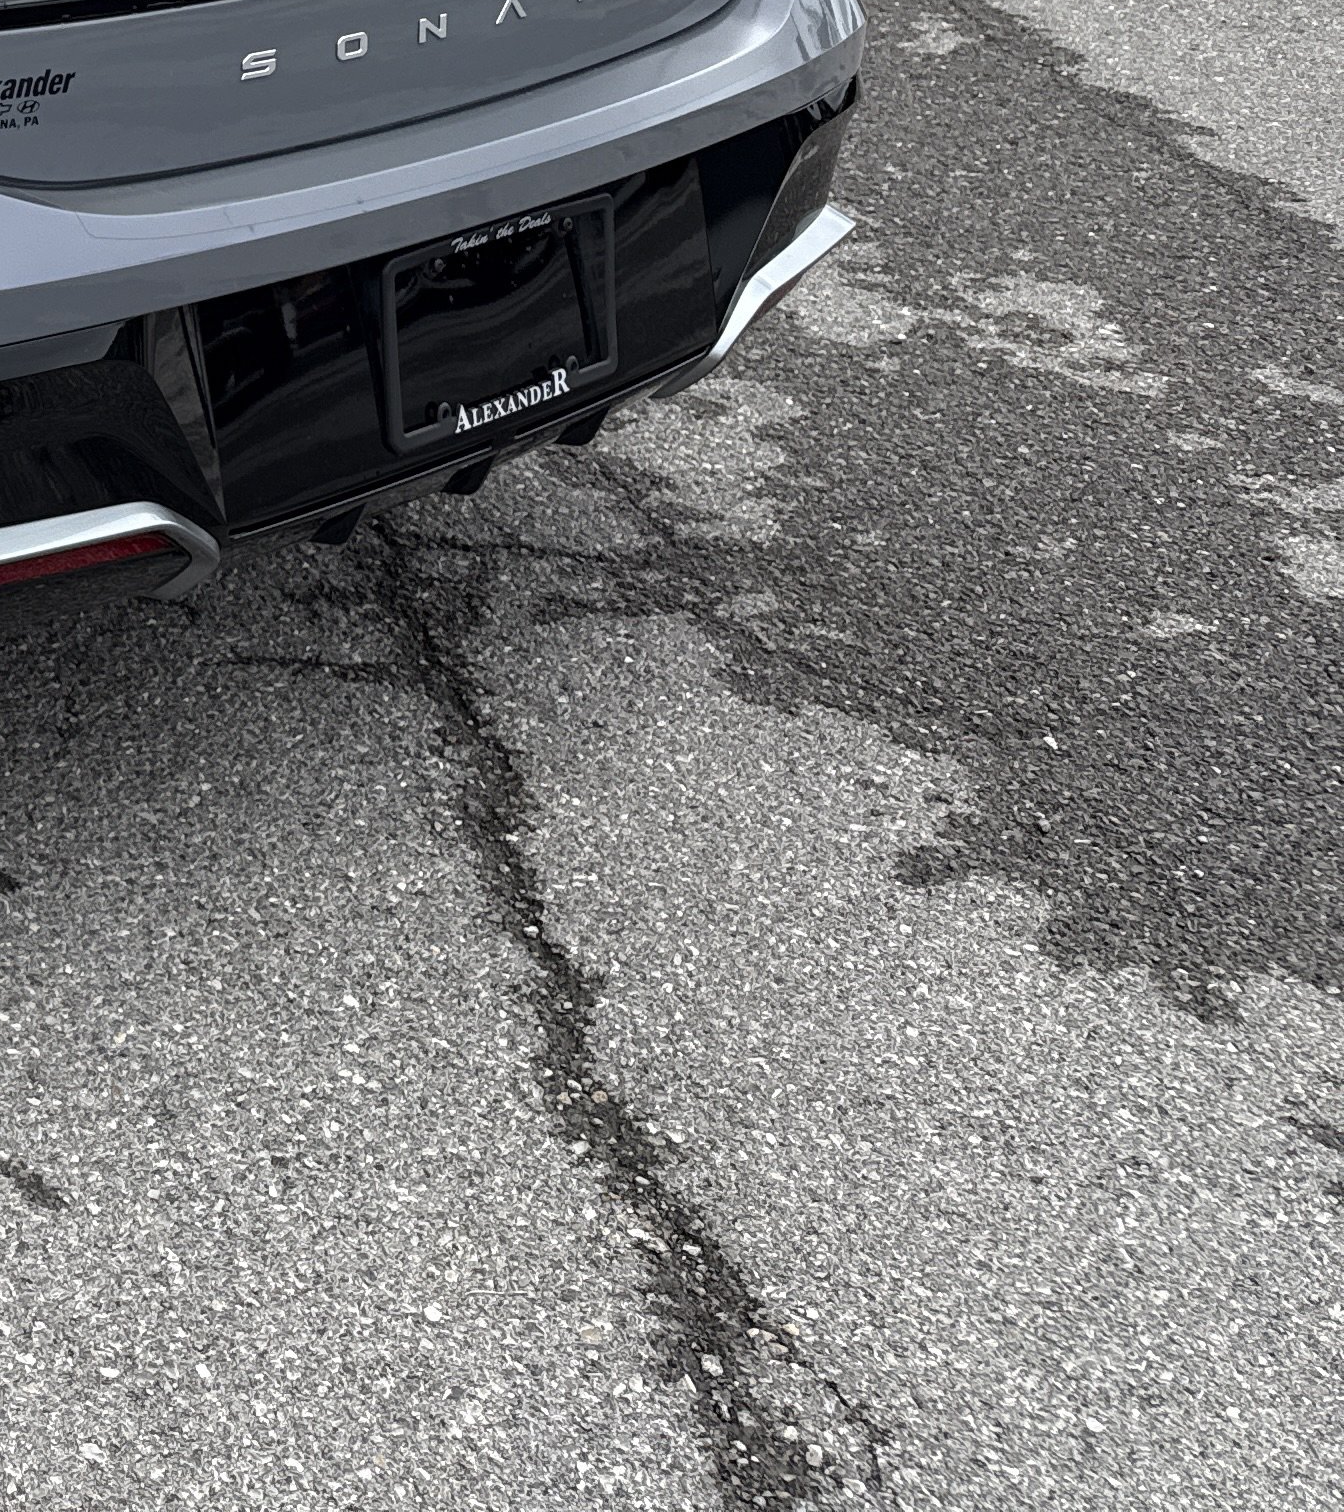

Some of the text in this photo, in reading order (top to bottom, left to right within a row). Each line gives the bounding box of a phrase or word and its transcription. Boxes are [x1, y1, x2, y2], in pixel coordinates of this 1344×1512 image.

[23, 116, 40, 127] PA
[496, 221, 515, 240] the
[518, 212, 552, 233] Deals
